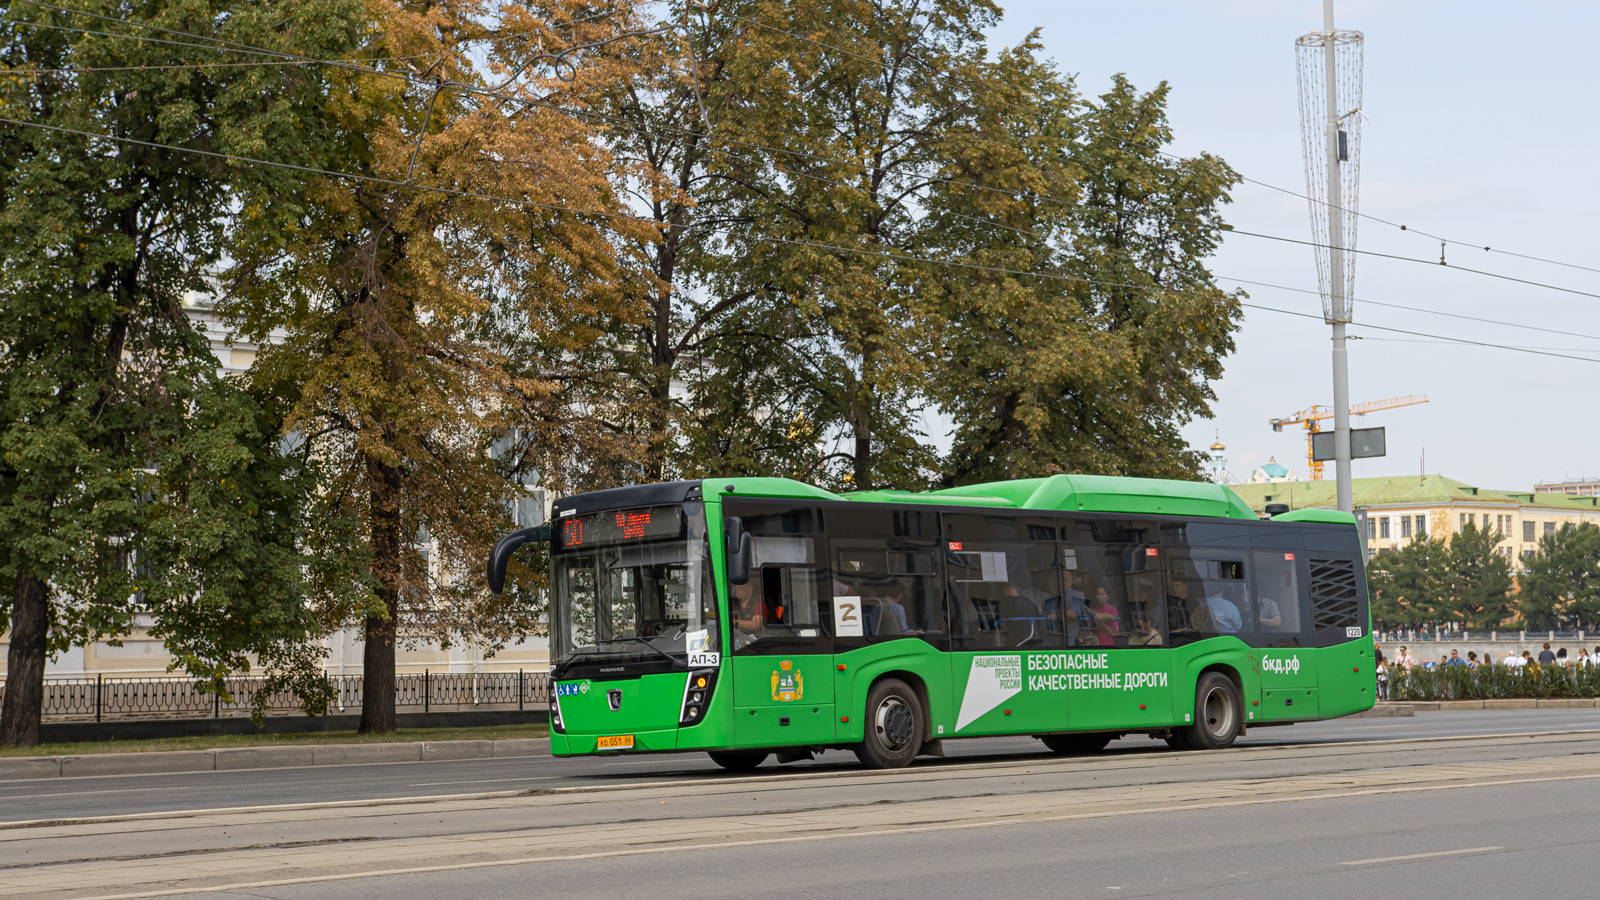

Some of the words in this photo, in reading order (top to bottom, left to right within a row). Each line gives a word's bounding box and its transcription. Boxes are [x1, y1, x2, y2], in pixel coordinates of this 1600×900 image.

[839, 603, 857, 621] Z
[1347, 628, 1361, 636] 1220
[690, 654, 718, 665] АП-3
[975, 656, 1020, 668] НАЦИОНАЛЬНЫЕ
[1027, 653, 1109, 671] БЕЗОПАСНЫЕ
[1262, 654, 1300, 675] бкд.рф
[995, 668, 1021, 678] ПРОЕКТЫ
[999, 679, 1021, 690] РОССИИ
[1028, 673, 1122, 691] КАЧЕСТВЕННЫЕ
[1123, 672, 1168, 691] ДОРОГИ
[610, 737, 622, 746] 051
